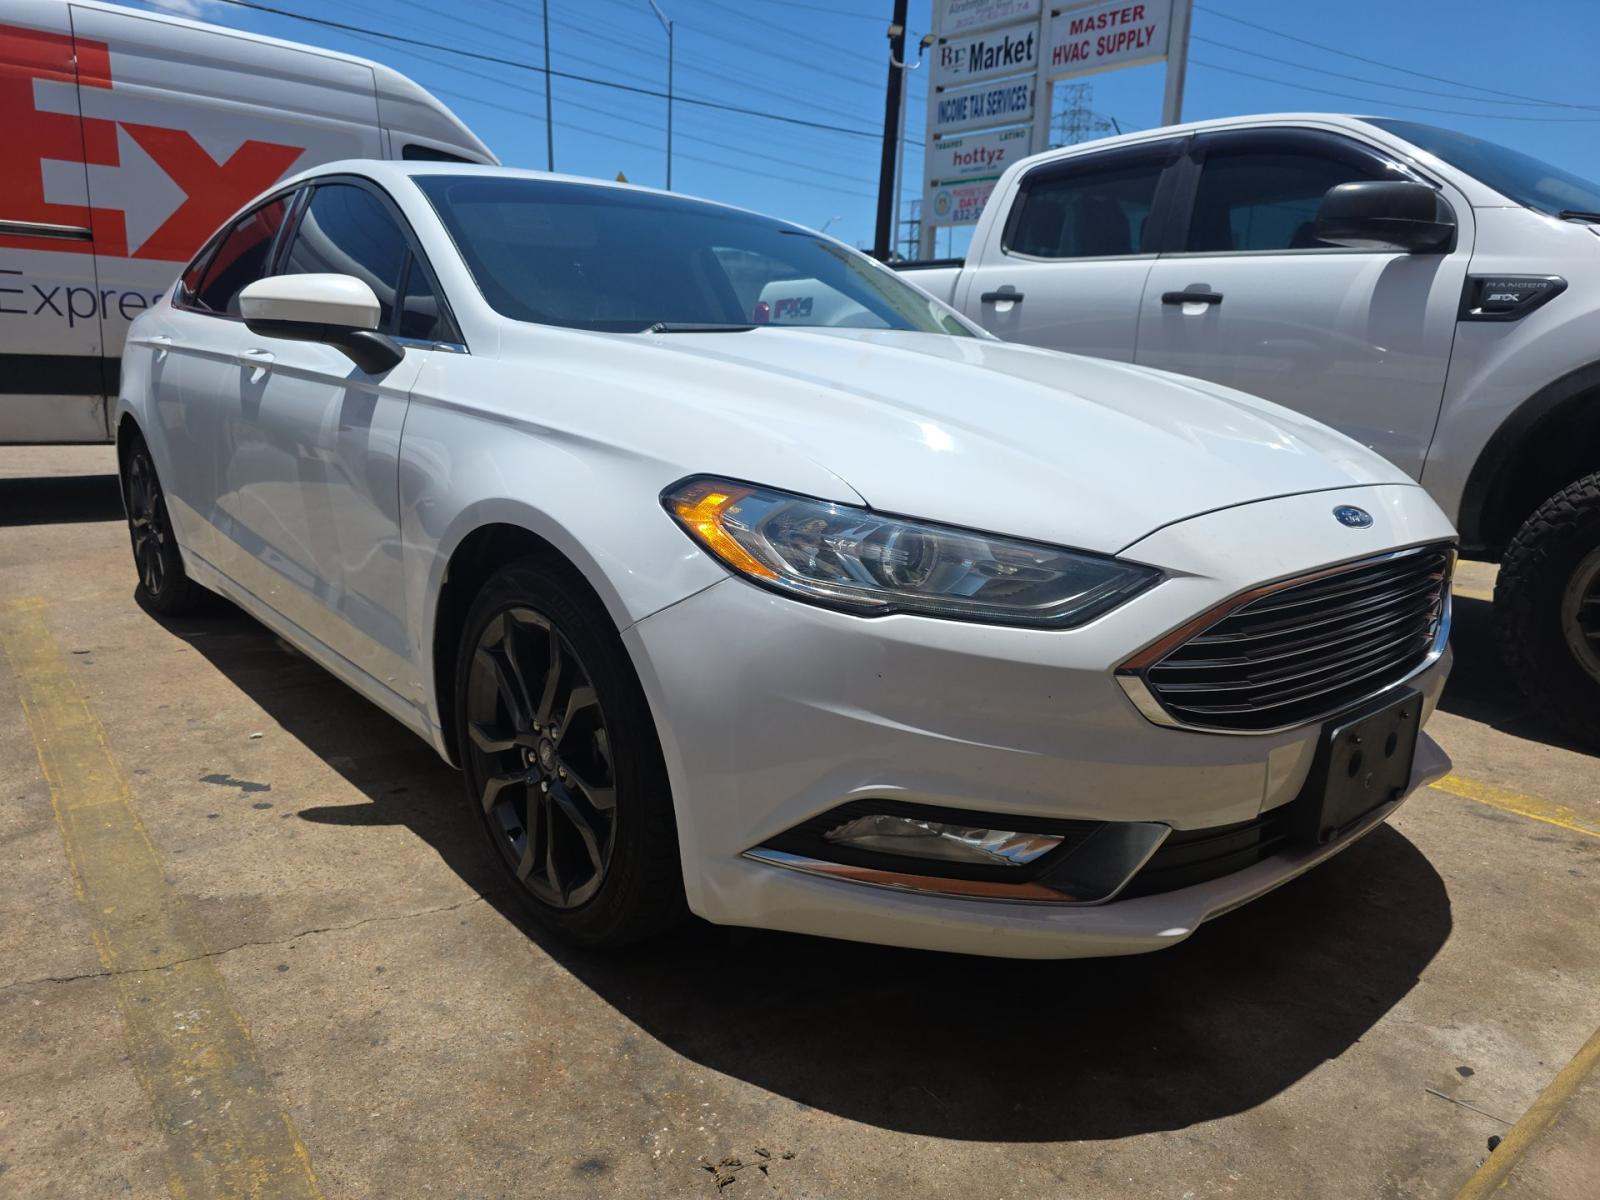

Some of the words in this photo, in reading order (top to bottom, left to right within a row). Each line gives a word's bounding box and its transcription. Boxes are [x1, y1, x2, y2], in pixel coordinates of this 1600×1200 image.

[1069, 4, 1145, 36] MASTER
[968, 31, 1034, 73] Market
[1052, 40, 1091, 65] HVAC
[1096, 25, 1156, 56] SUPPLY
[937, 96, 969, 124] INCOME
[969, 92, 985, 119] TAX
[986, 85, 1027, 116] SERVICES
[999, 129, 1026, 141] LATINO
[953, 146, 1005, 166] hottyz
[0, 269, 164, 328] Expre
[774, 296, 814, 319] FX4
